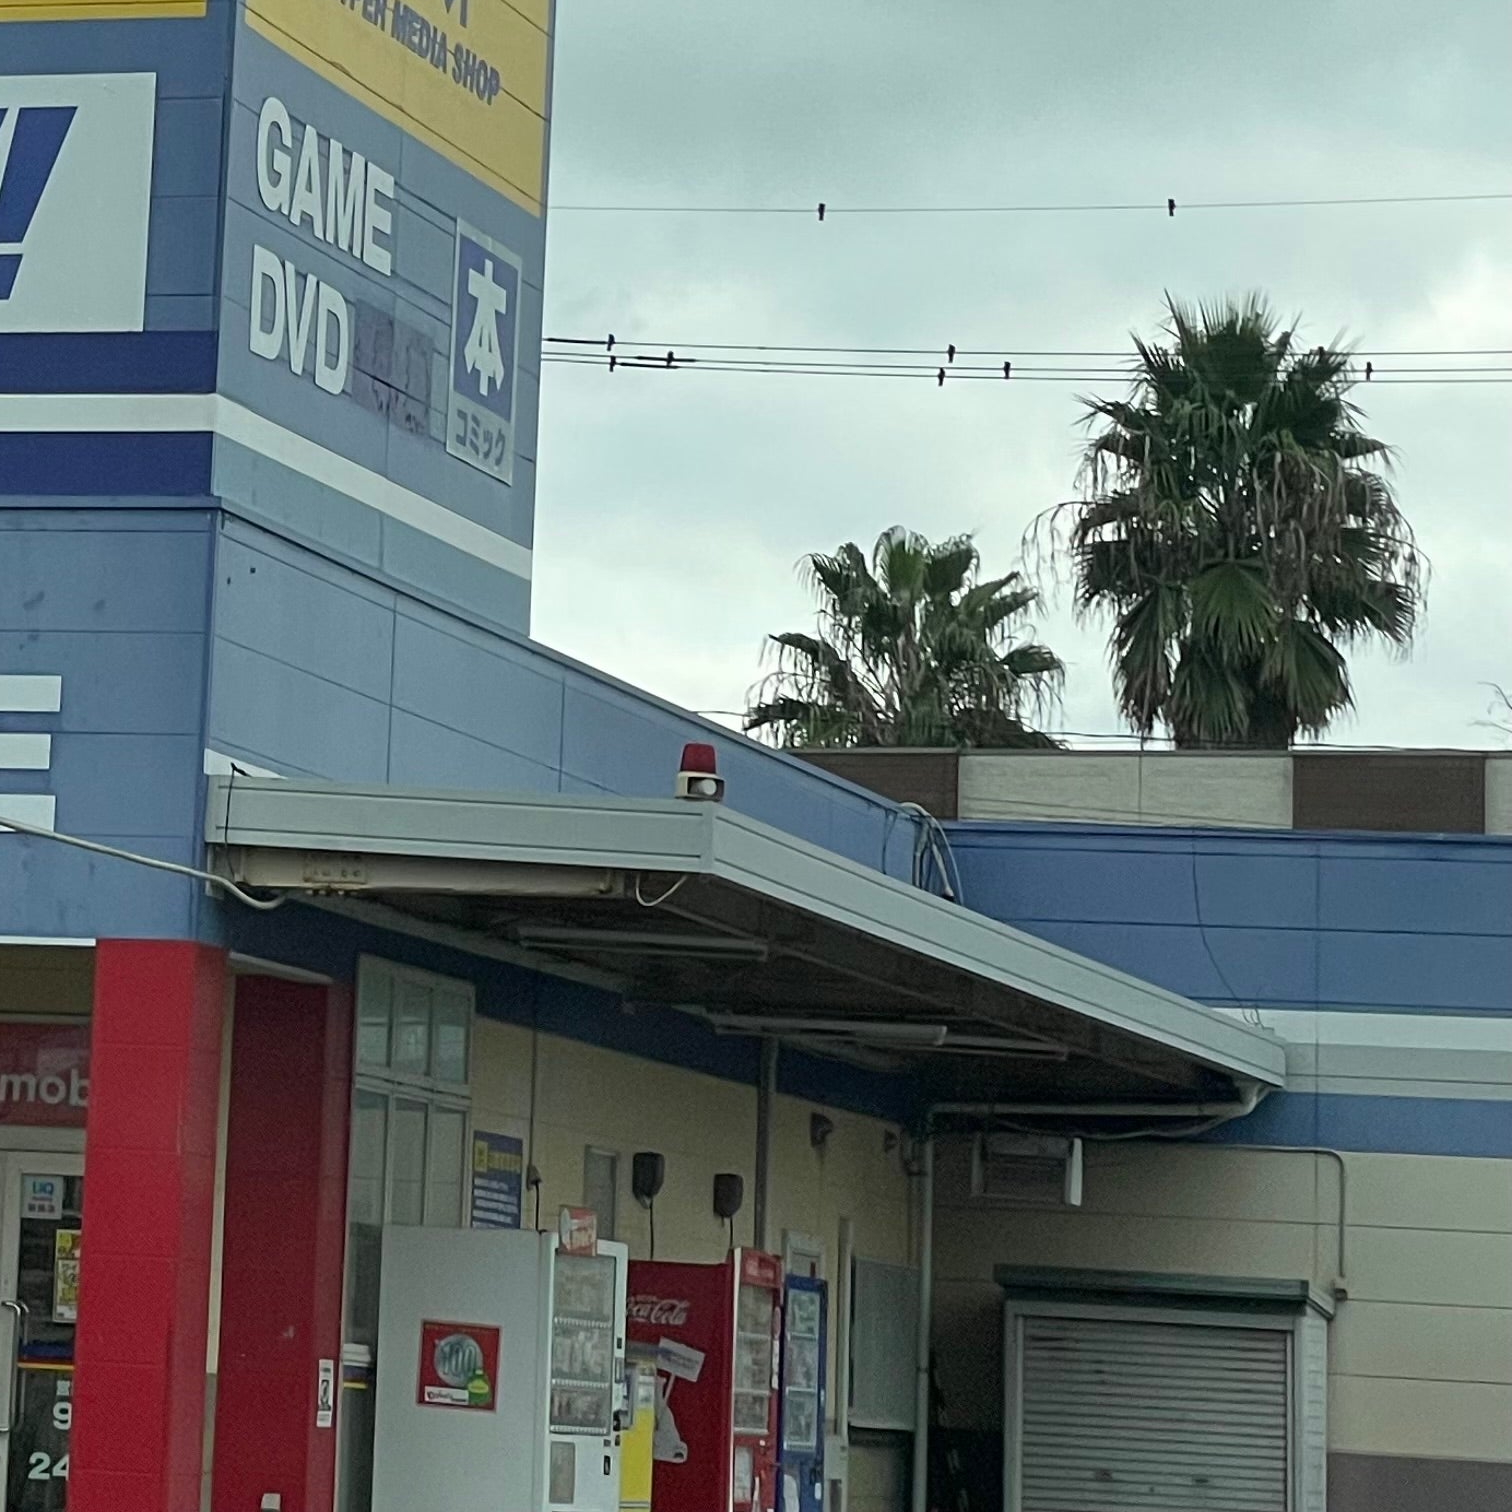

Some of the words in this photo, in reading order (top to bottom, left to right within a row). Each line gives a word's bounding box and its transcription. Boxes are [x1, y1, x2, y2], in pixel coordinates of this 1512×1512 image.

[391, 0, 448, 74] MEDIA
[452, 42, 500, 106] SHOP
[256, 96, 395, 276] GAME
[249, 244, 349, 395] DVD
[463, 259, 506, 397] 本
[455, 408, 506, 468] コミック
